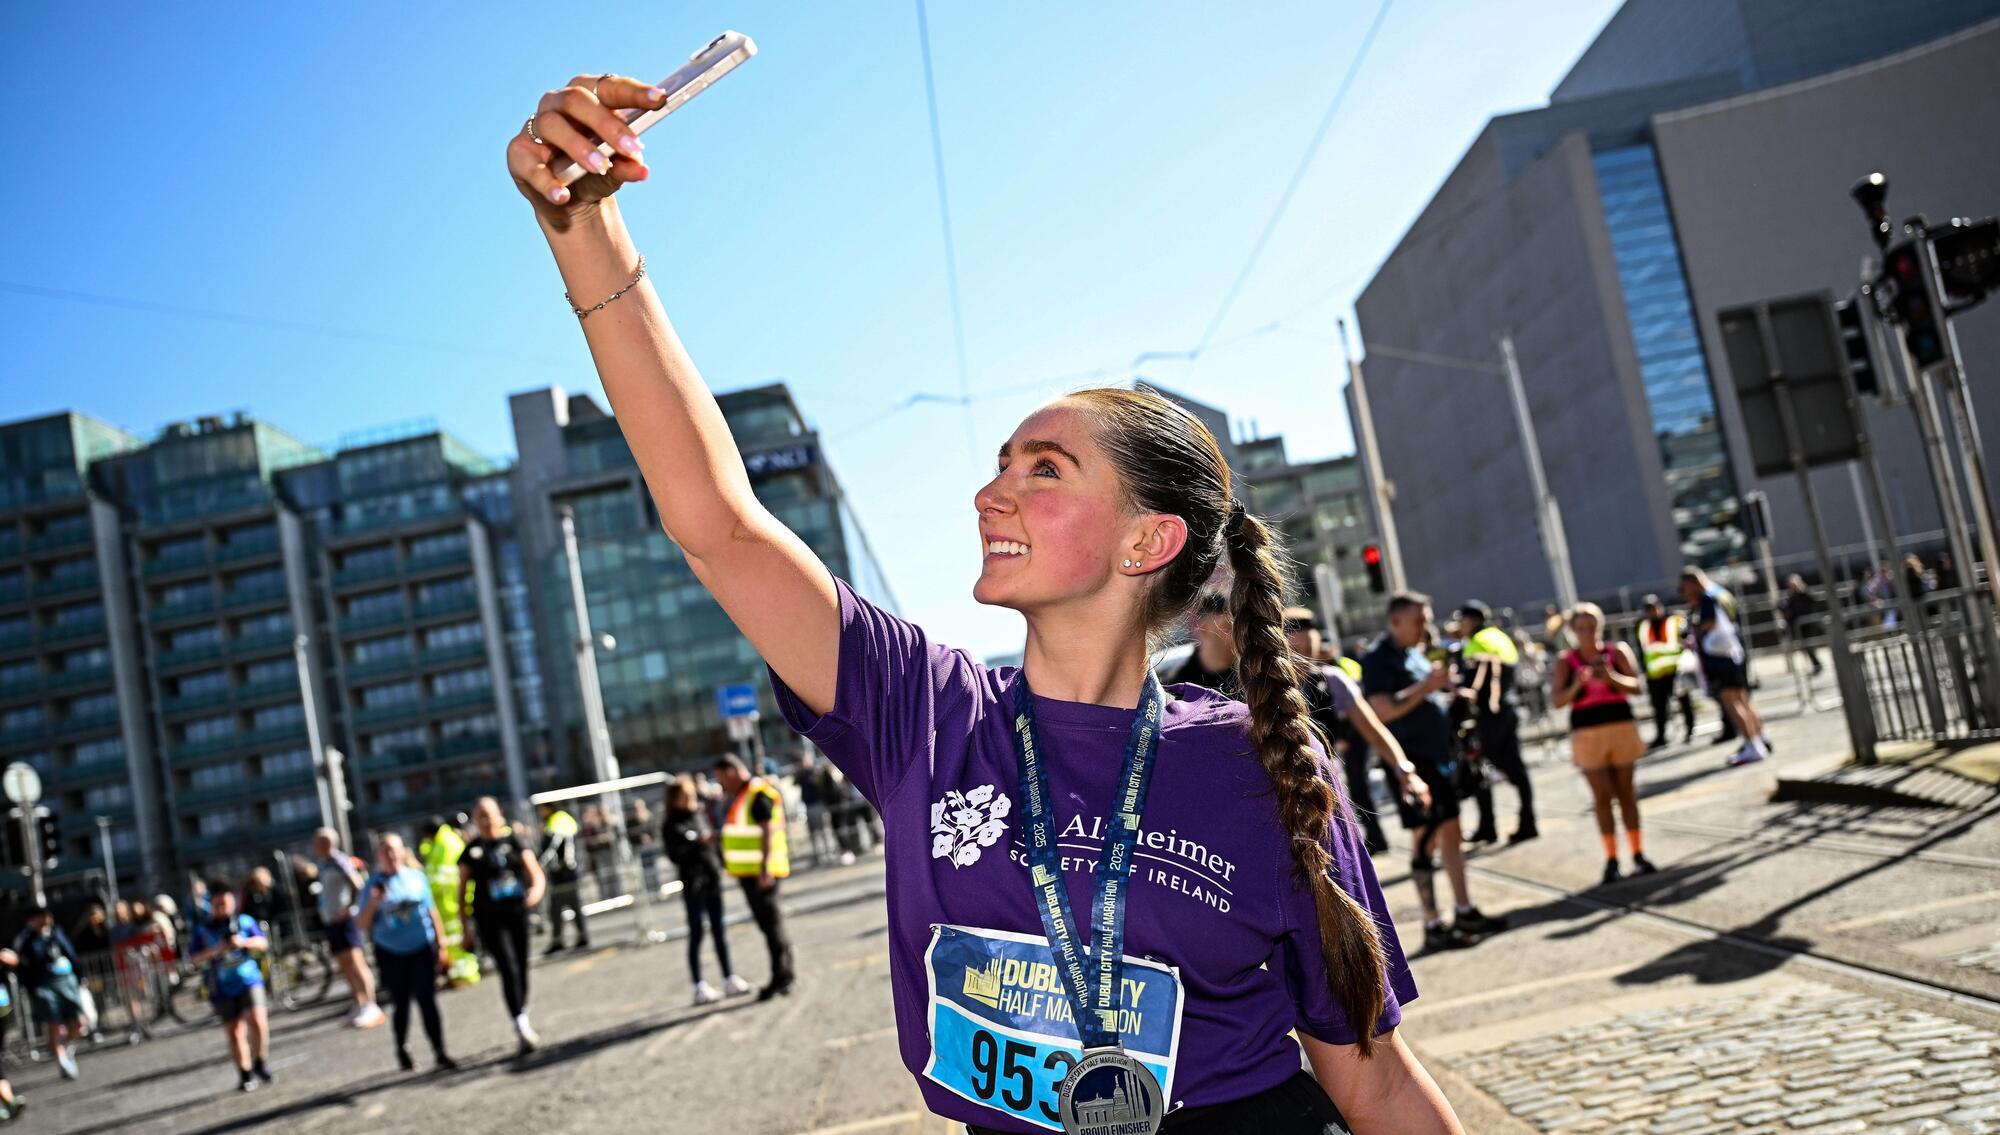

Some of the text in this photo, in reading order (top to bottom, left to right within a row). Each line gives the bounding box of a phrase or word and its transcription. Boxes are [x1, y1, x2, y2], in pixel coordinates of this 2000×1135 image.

[1021, 725, 1033, 751] DUBLIN
[1025, 749, 1036, 767] CITY
[1123, 698, 1158, 813] DUBLIN CITY HALF MARATHON 2025
[1033, 822, 1047, 848] 2025
[1059, 814, 1235, 882] Aleimer
[1009, 849, 1098, 873] SETY
[1148, 868, 1231, 914] IRELAND
[1044, 884, 1062, 920] DUBLIN
[1053, 919, 1070, 940] CITY
[1098, 842, 1125, 1008] DUBLIN CITY HALF MARATHON 2025
[1060, 941, 1077, 962] HALF
[1002, 958, 1146, 1009] DUBL TY
[998, 988, 1047, 1018] HALF
[1073, 1064, 1087, 1080] CITY
[1085, 1058, 1099, 1068] HALF
[1099, 1056, 1129, 1066] MARATHON
[1111, 1121, 1151, 1135] FINISHER
